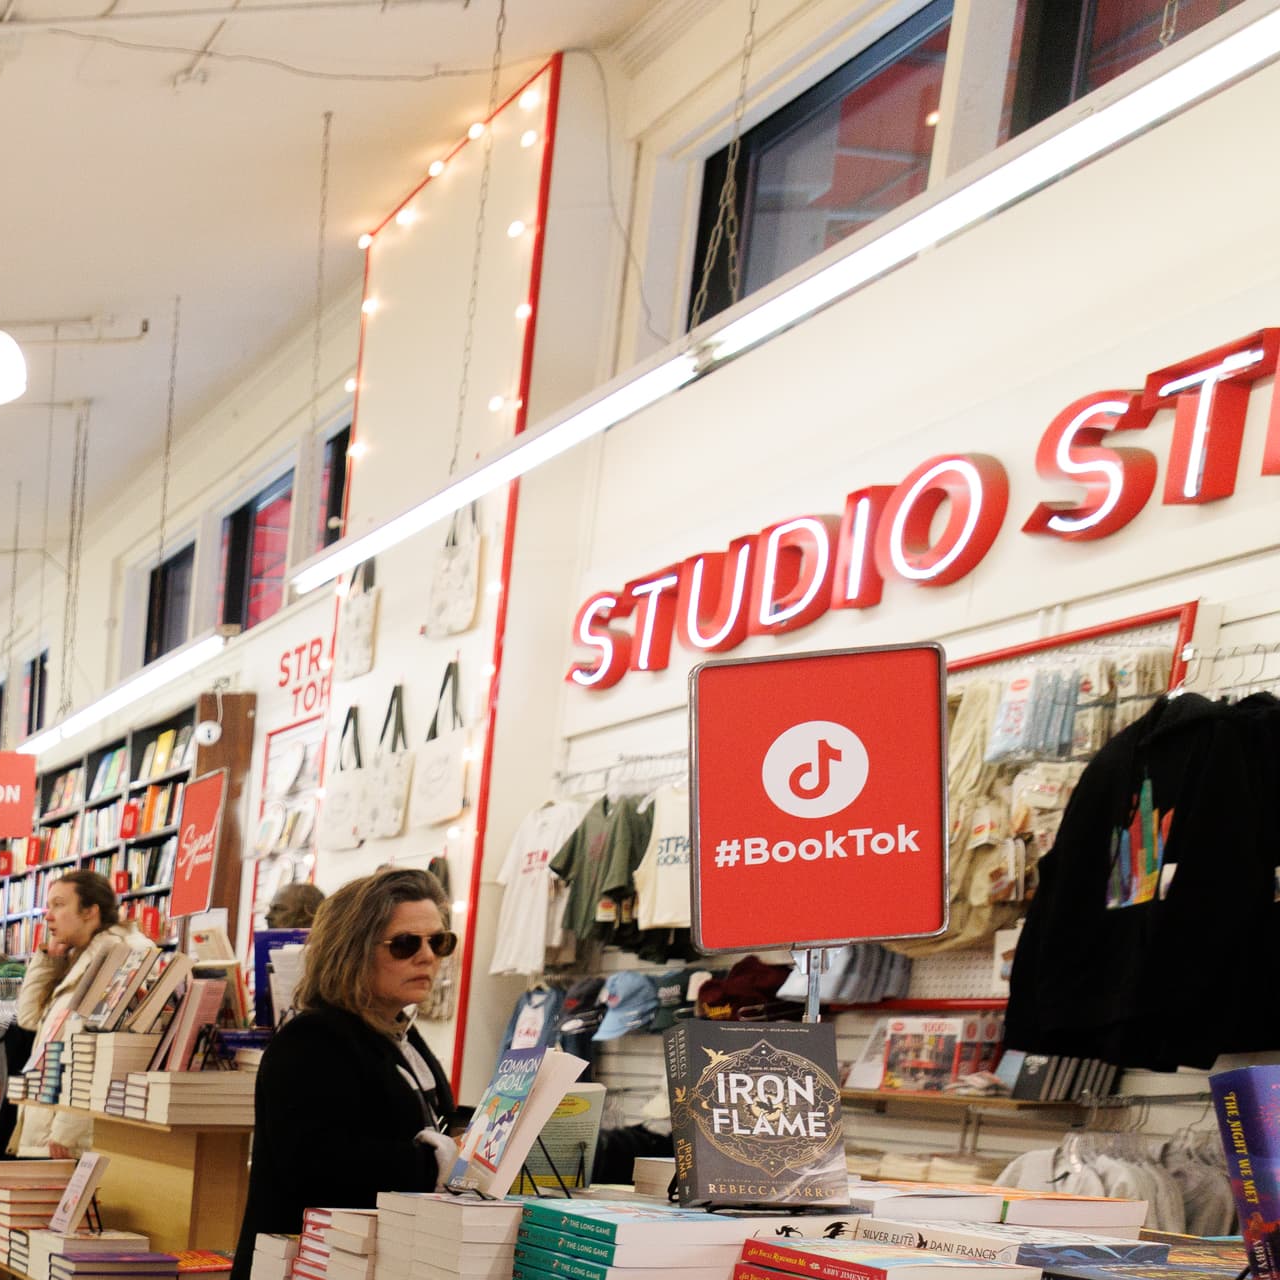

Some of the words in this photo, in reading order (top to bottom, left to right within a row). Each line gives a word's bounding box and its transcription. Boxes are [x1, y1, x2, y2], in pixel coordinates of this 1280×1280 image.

[564, 453, 1009, 690] STUDIO
[1021, 326, 1280, 542] ST
[715, 823, 921, 870] #BookTok
[498, 1057, 541, 1074] COMMON
[667, 1038, 677, 1079] YARROS
[496, 1073, 524, 1091] GOAL
[716, 1073, 814, 1106] IRON
[1226, 1091, 1238, 1117] THE
[712, 1108, 827, 1137] FLAME
[1230, 1118, 1247, 1154] NIGHT
[677, 1138, 687, 1180] FLAME
[1238, 1155, 1252, 1177] WE
[708, 1183, 777, 1194] REBECCA
[1245, 1177, 1259, 1204] MET
[569, 1219, 579, 1228] THE
[580, 1221, 594, 1232] LONG
[595, 1225, 610, 1236] GAME
[862, 1229, 890, 1244] SILVER
[891, 1235, 914, 1247] ELITE
[929, 1240, 954, 1253] DANI
[955, 1246, 997, 1261] FRANCIS
[1252, 1238, 1265, 1273] ABBY
[823, 1266, 840, 1277] ABBY
